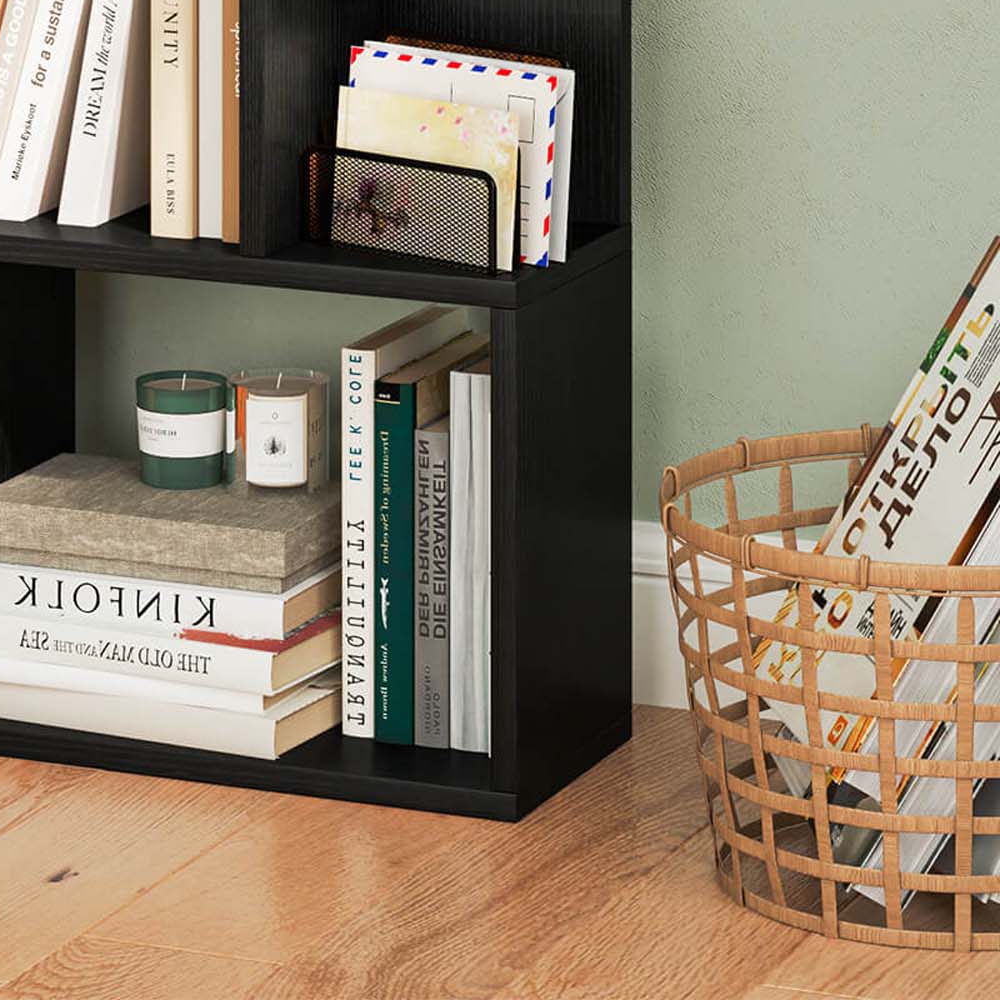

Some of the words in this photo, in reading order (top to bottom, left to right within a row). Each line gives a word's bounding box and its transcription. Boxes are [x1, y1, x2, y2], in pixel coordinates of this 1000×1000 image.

[102, 4, 116, 45] world
[3, 52, 15, 64] A
[31, 64, 48, 88] for
[41, 50, 52, 61] a
[95, 45, 110, 67] the
[83, 68, 107, 138] DREAM
[11, 142, 27, 181] Marieke
[20, 103, 37, 141] Eyskoot
[166, 153, 176, 187] EULA
[166, 189, 176, 214] BISS
[842, 303, 995, 556] ОТКРЫТЬ
[878, 387, 972, 550] ДЕЛО
